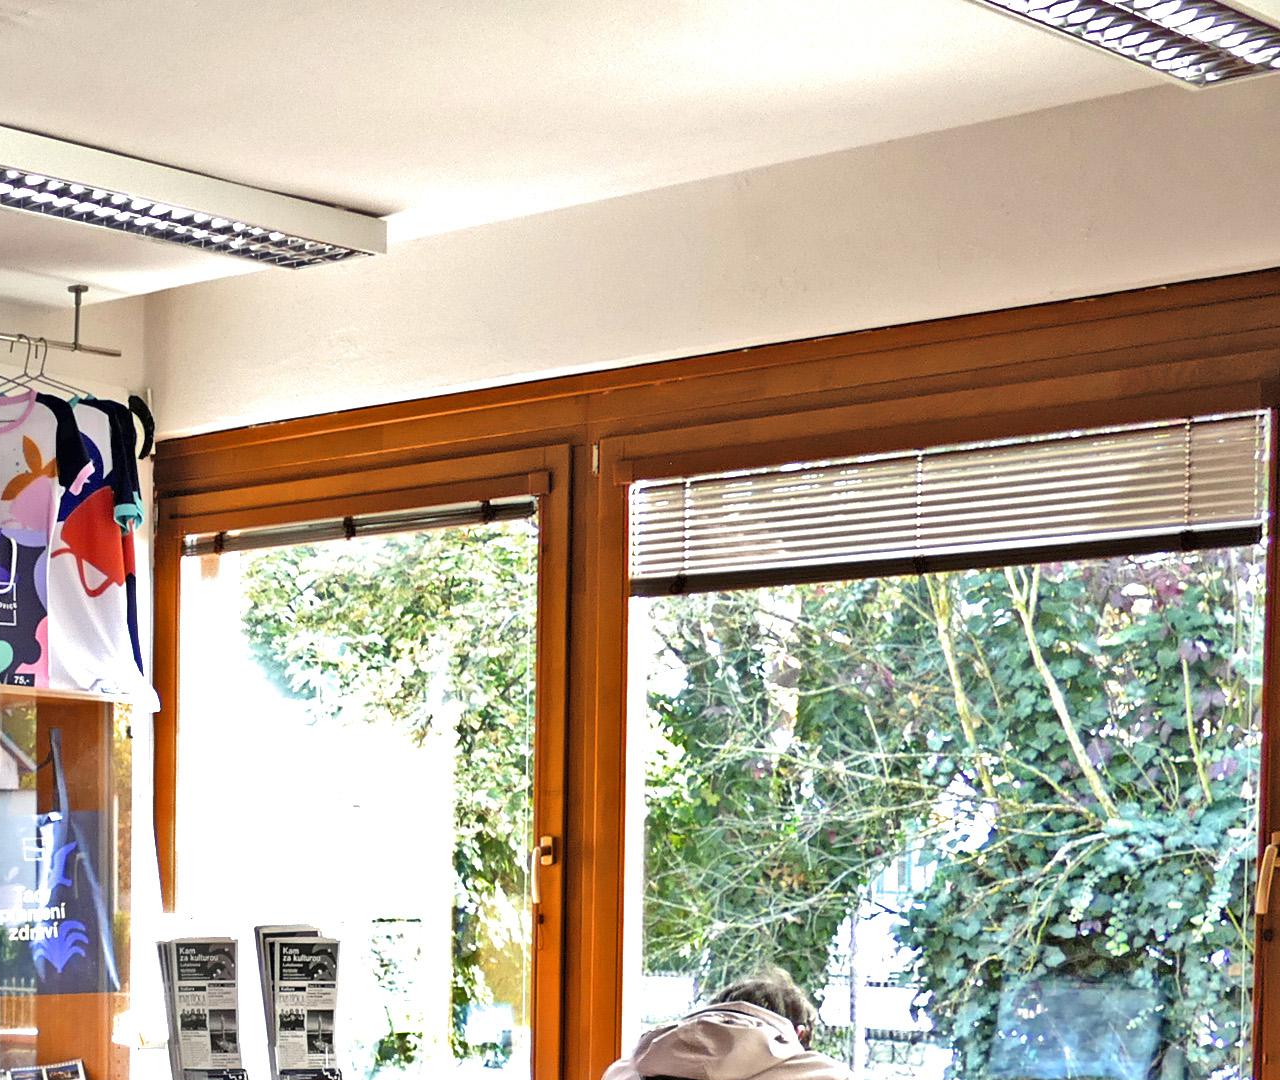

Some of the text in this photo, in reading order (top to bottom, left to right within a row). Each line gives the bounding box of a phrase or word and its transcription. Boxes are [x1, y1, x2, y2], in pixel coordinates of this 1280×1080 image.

[13, 675, 30, 685] 75,-
[179, 947, 196, 955] Kam
[282, 947, 300, 955] Kam
